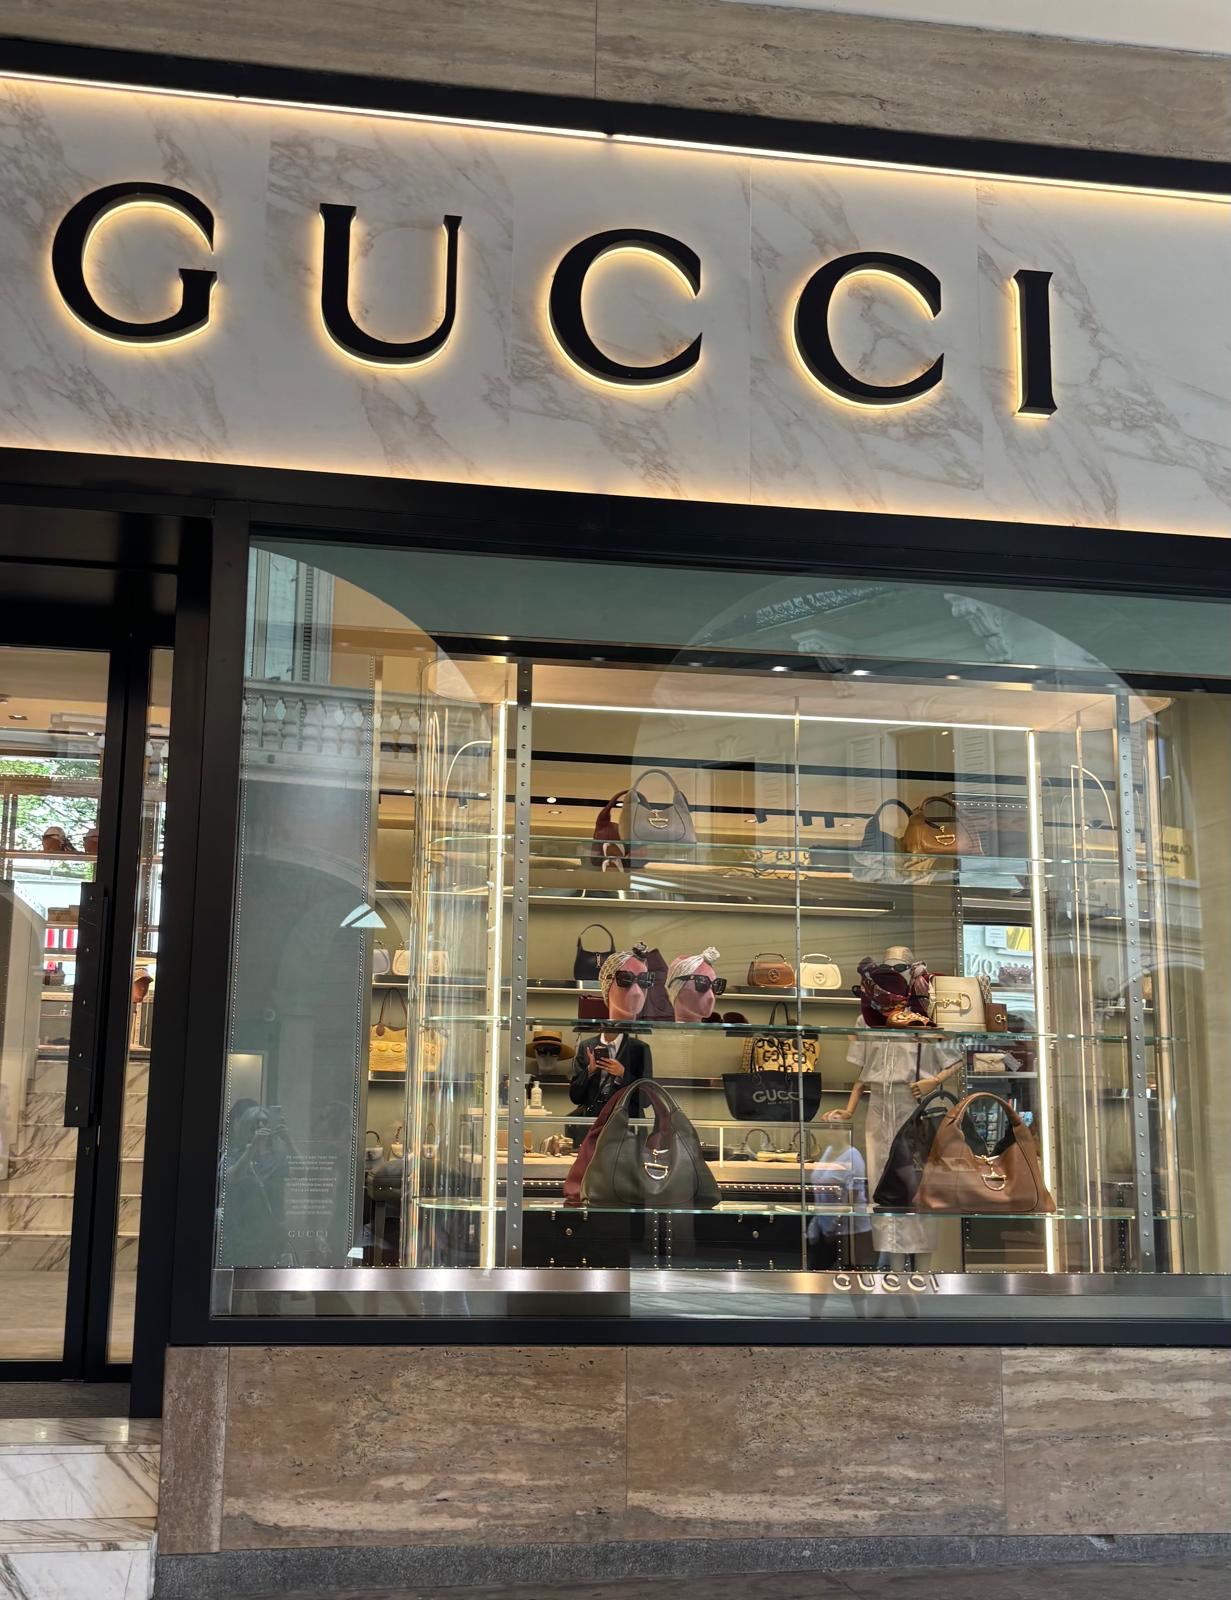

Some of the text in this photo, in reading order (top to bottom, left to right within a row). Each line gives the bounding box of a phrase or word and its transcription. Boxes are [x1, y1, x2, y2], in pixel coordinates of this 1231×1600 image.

[52, 182, 1057, 417] GUCCI
[752, 1089, 803, 1103] GUCC
[288, 1230, 329, 1239] GUCCI
[833, 1273, 940, 1292] GUCCI
